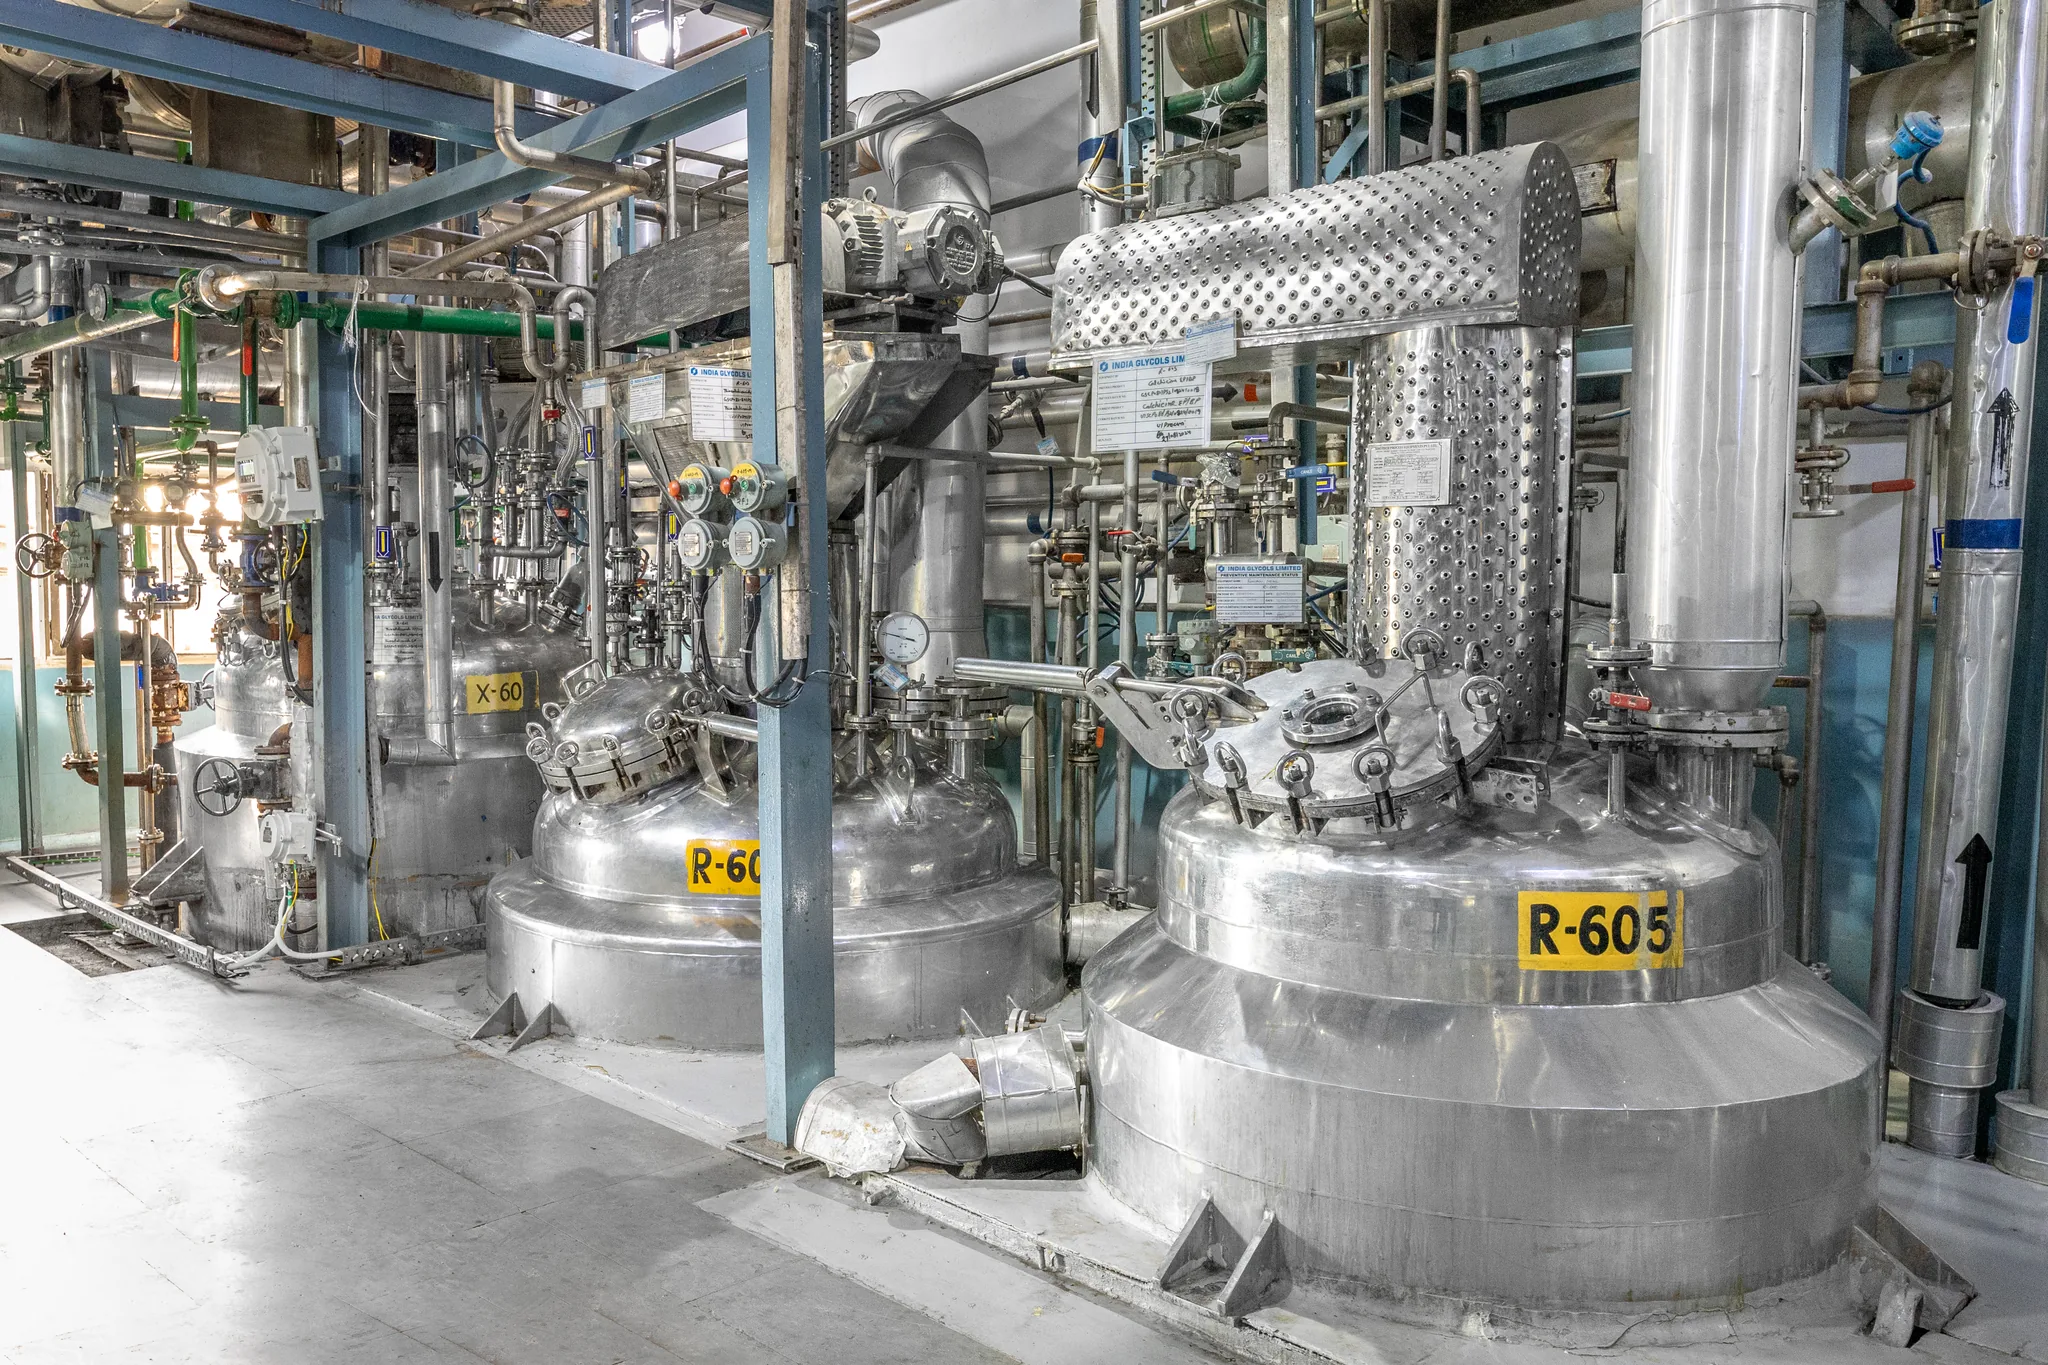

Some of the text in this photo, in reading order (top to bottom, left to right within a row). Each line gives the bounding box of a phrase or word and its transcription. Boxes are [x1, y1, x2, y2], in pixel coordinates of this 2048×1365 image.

[1112, 360, 1134, 370] INDIA
[1135, 356, 1170, 369] GLYCOLS
[476, 682, 522, 704] X-60
[693, 847, 760, 884] R-60
[1530, 903, 1672, 956] R-605
